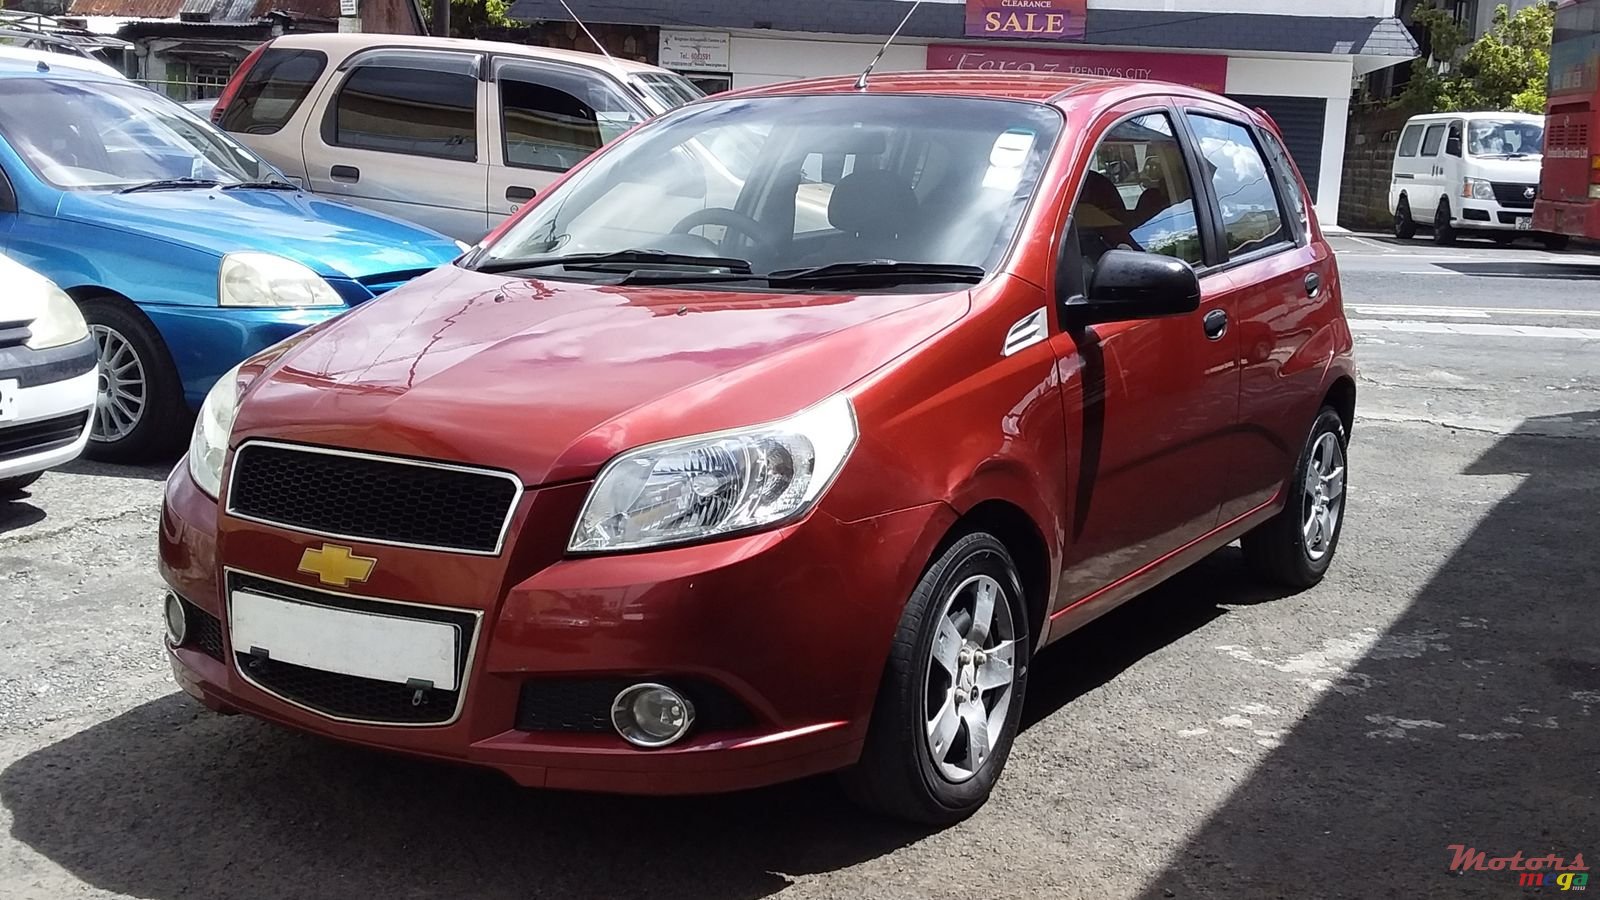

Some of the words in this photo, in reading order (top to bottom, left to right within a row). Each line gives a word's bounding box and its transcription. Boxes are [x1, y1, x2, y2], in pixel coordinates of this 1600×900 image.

[1001, 0, 1051, 8] CLEARANCE
[985, 11, 1065, 33] SALE
[1126, 68, 1152, 80] CITY
